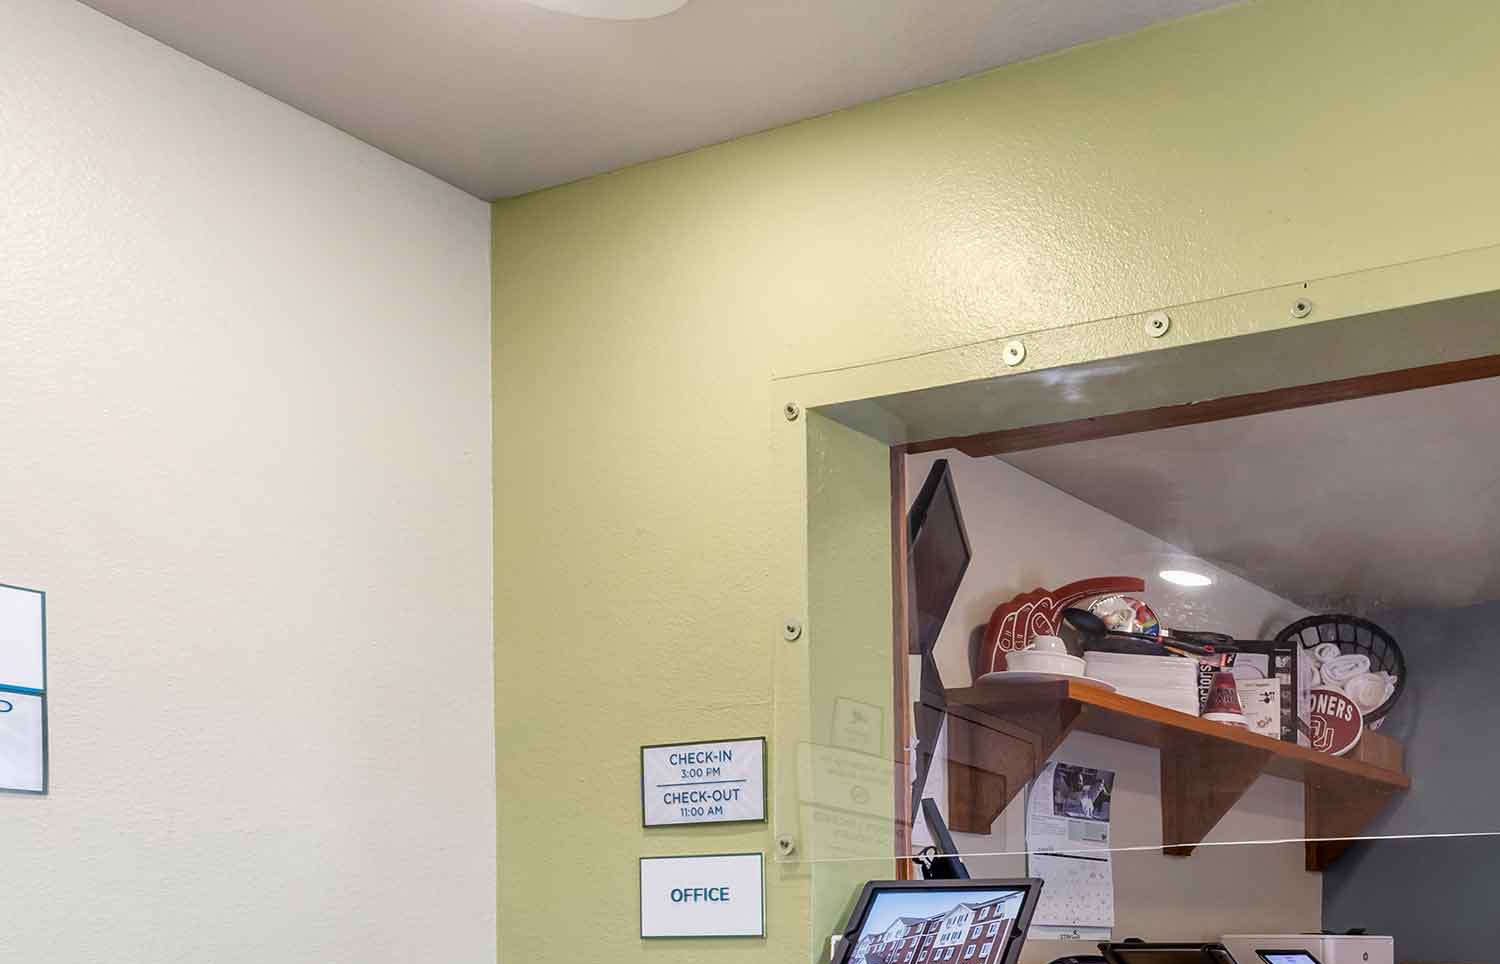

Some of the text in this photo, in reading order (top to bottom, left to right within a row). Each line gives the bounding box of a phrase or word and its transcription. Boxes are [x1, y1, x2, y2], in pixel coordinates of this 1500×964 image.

[669, 749, 732, 766] CHECK-IN
[681, 767, 721, 778] 3:00 PM
[663, 788, 740, 805] CHECK-OUT
[680, 806, 723, 817] 11:00 AM
[670, 887, 730, 902] OFFICE
